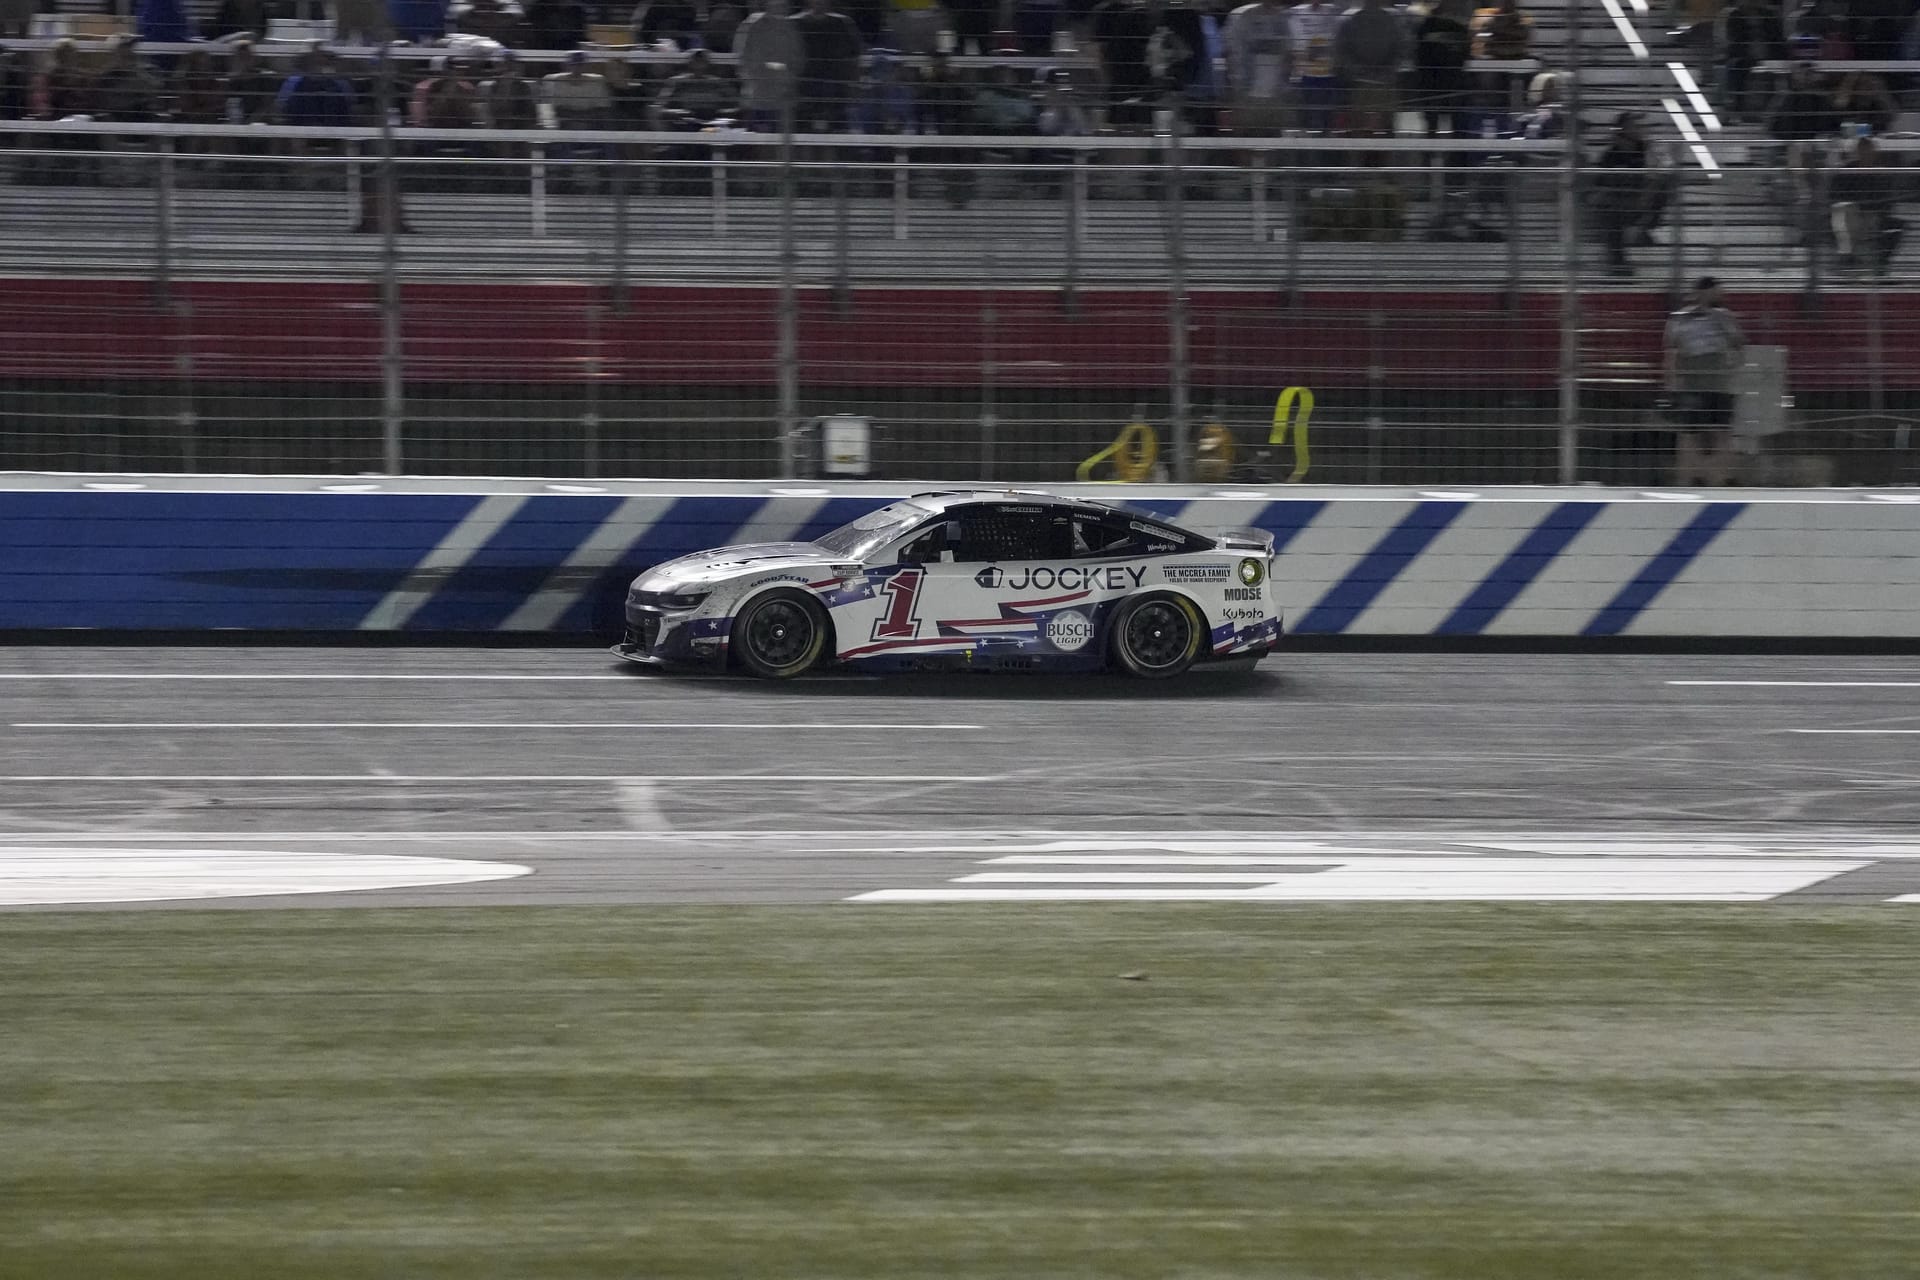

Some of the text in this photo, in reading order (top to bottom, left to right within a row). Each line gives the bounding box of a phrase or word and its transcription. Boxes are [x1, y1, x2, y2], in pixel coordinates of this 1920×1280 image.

[1073, 512, 1101, 521] SIEMENS
[1009, 566, 1147, 590] JOCKEY
[1163, 568, 1231, 578] THE MCCREA FAMILY
[750, 574, 809, 587] GOODYEAR
[1224, 587, 1262, 601] MOOSE
[869, 567, 924, 642] 1
[1223, 607, 1264, 619] Kubota
[1047, 623, 1095, 638] BUSCH
